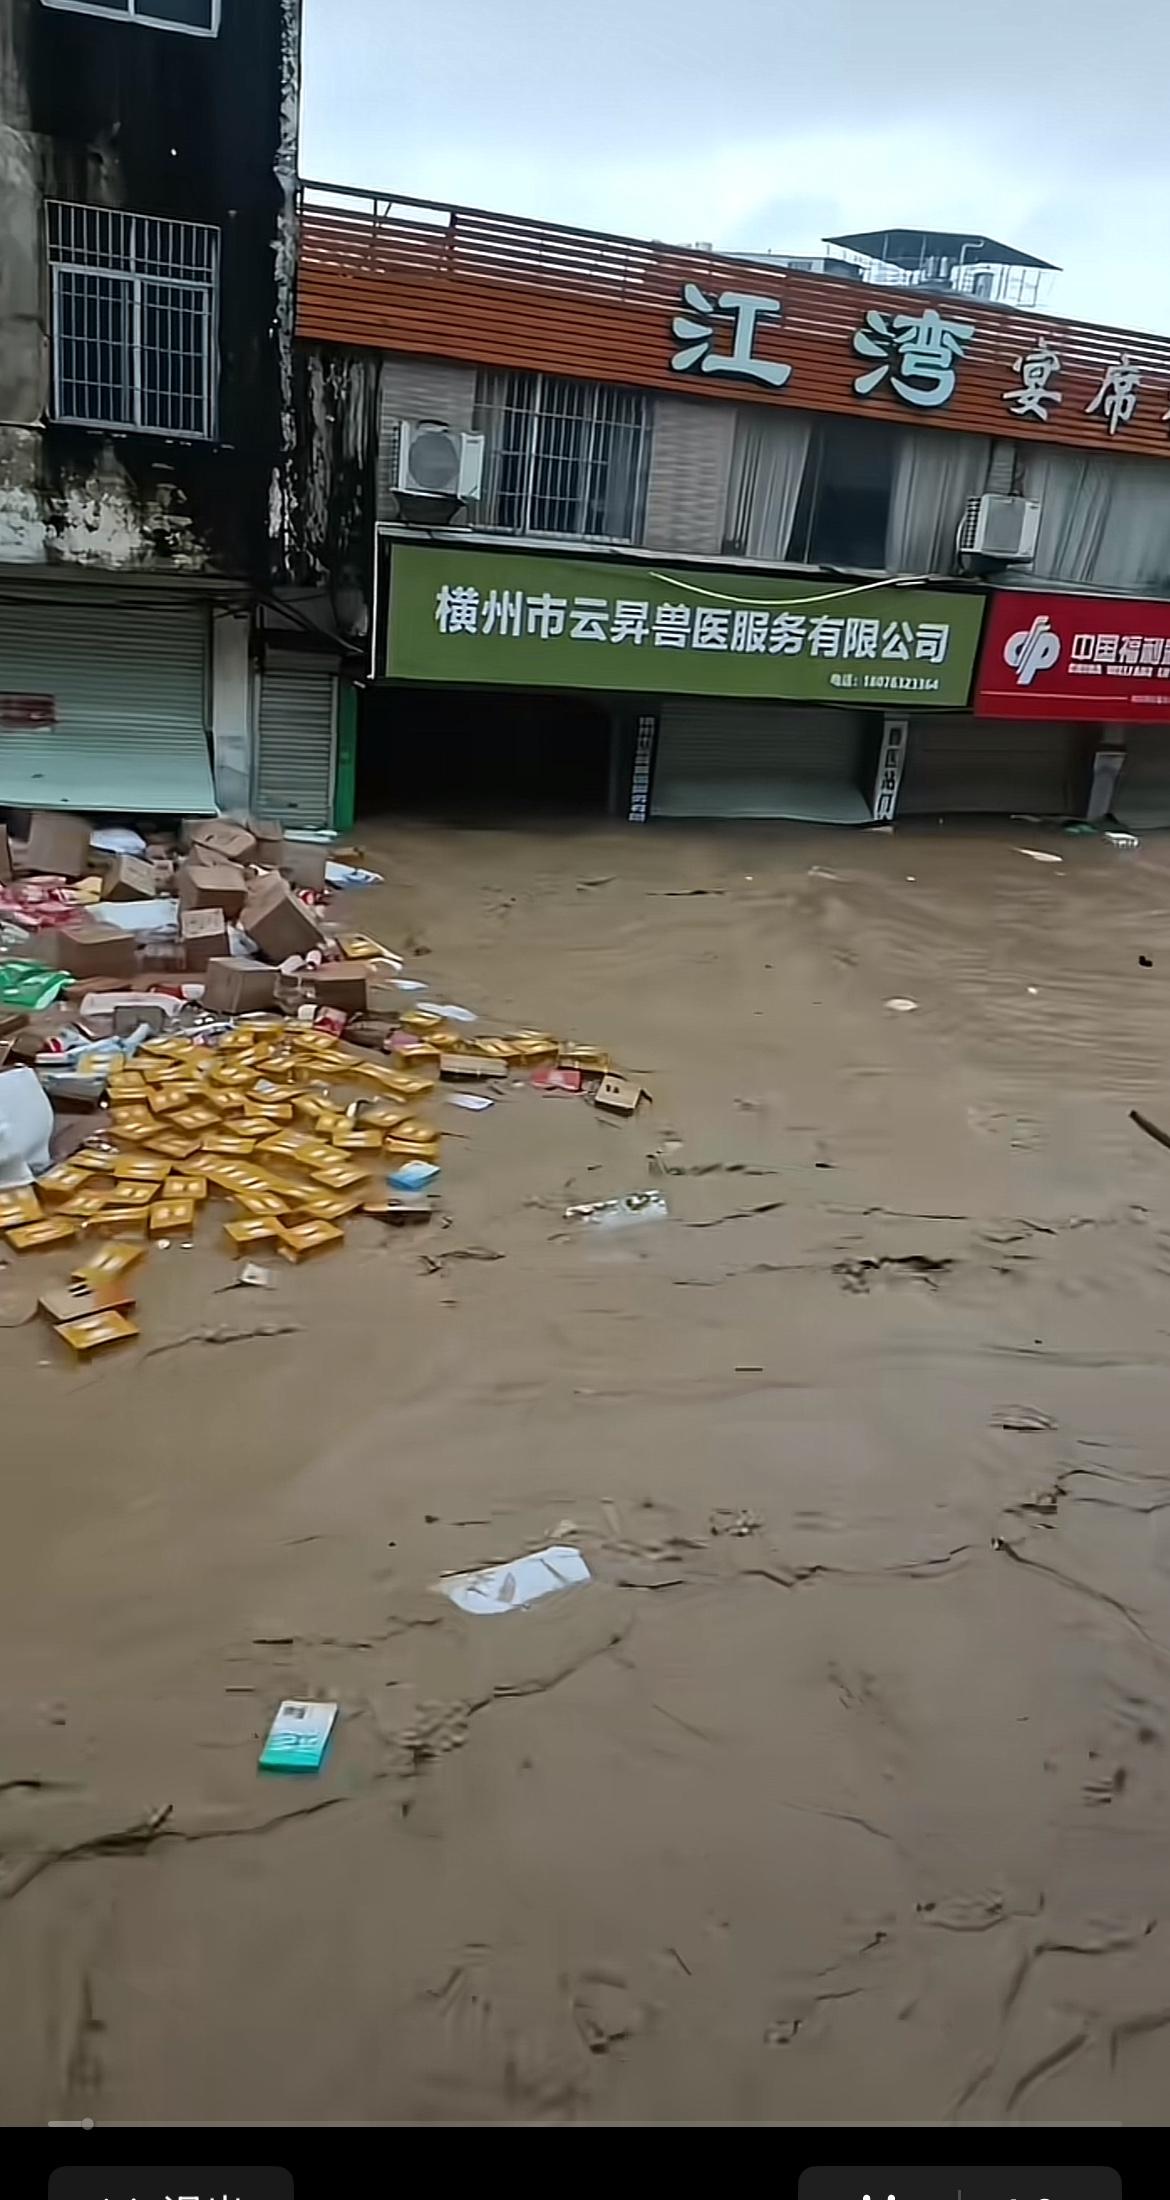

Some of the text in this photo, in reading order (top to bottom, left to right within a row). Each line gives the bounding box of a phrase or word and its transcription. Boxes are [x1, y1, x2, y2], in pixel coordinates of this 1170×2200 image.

[670, 283, 1170, 435] 江湾 宴席
[435, 585, 950, 664] 横州市云昇兽医服务有限公司
